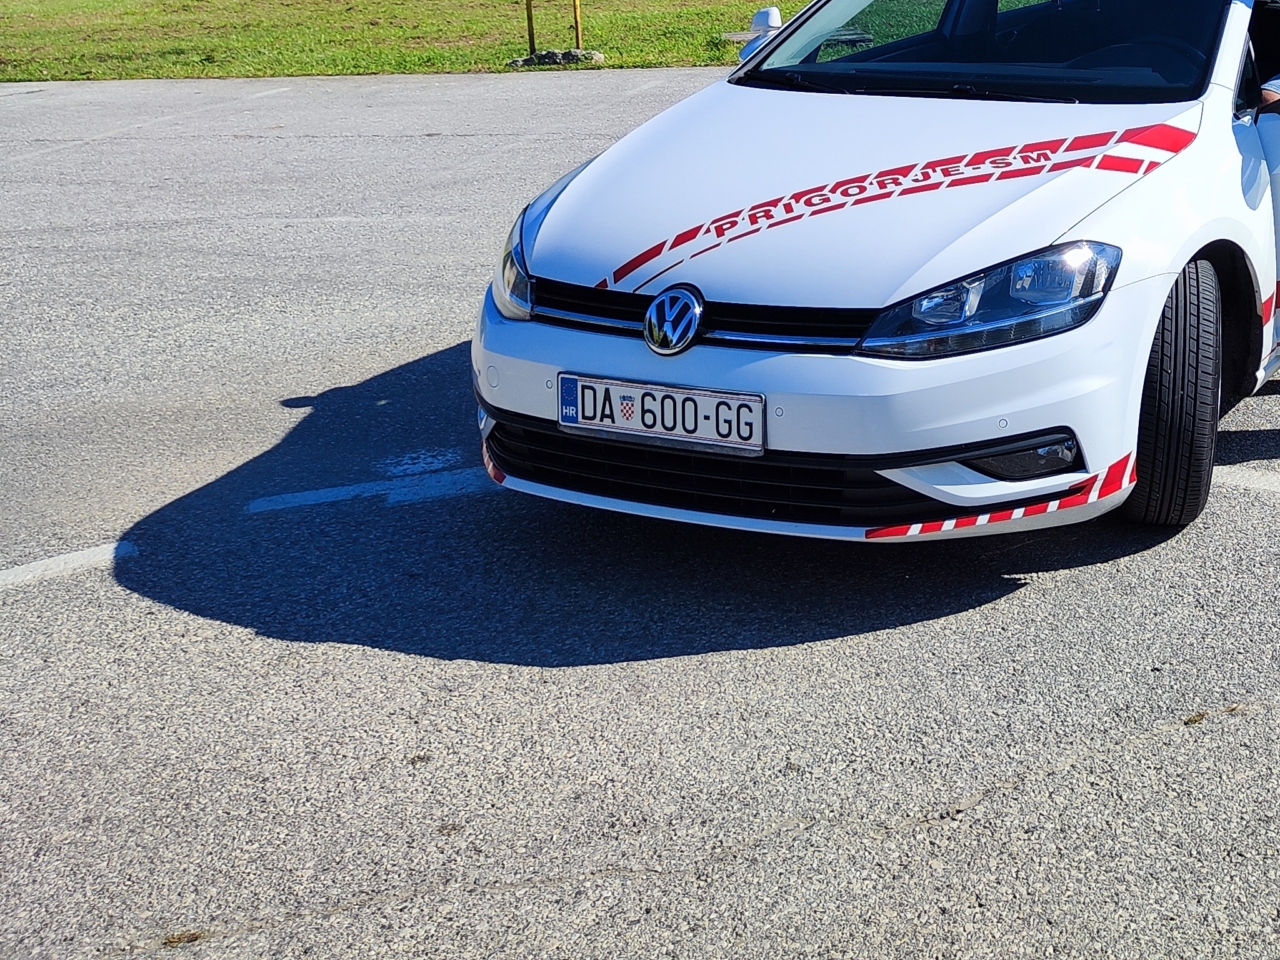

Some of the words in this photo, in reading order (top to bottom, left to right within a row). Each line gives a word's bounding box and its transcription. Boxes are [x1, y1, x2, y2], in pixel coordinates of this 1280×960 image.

[562, 405, 577, 418] HR
[581, 384, 616, 424] DA
[640, 391, 754, 442] 600-GG
